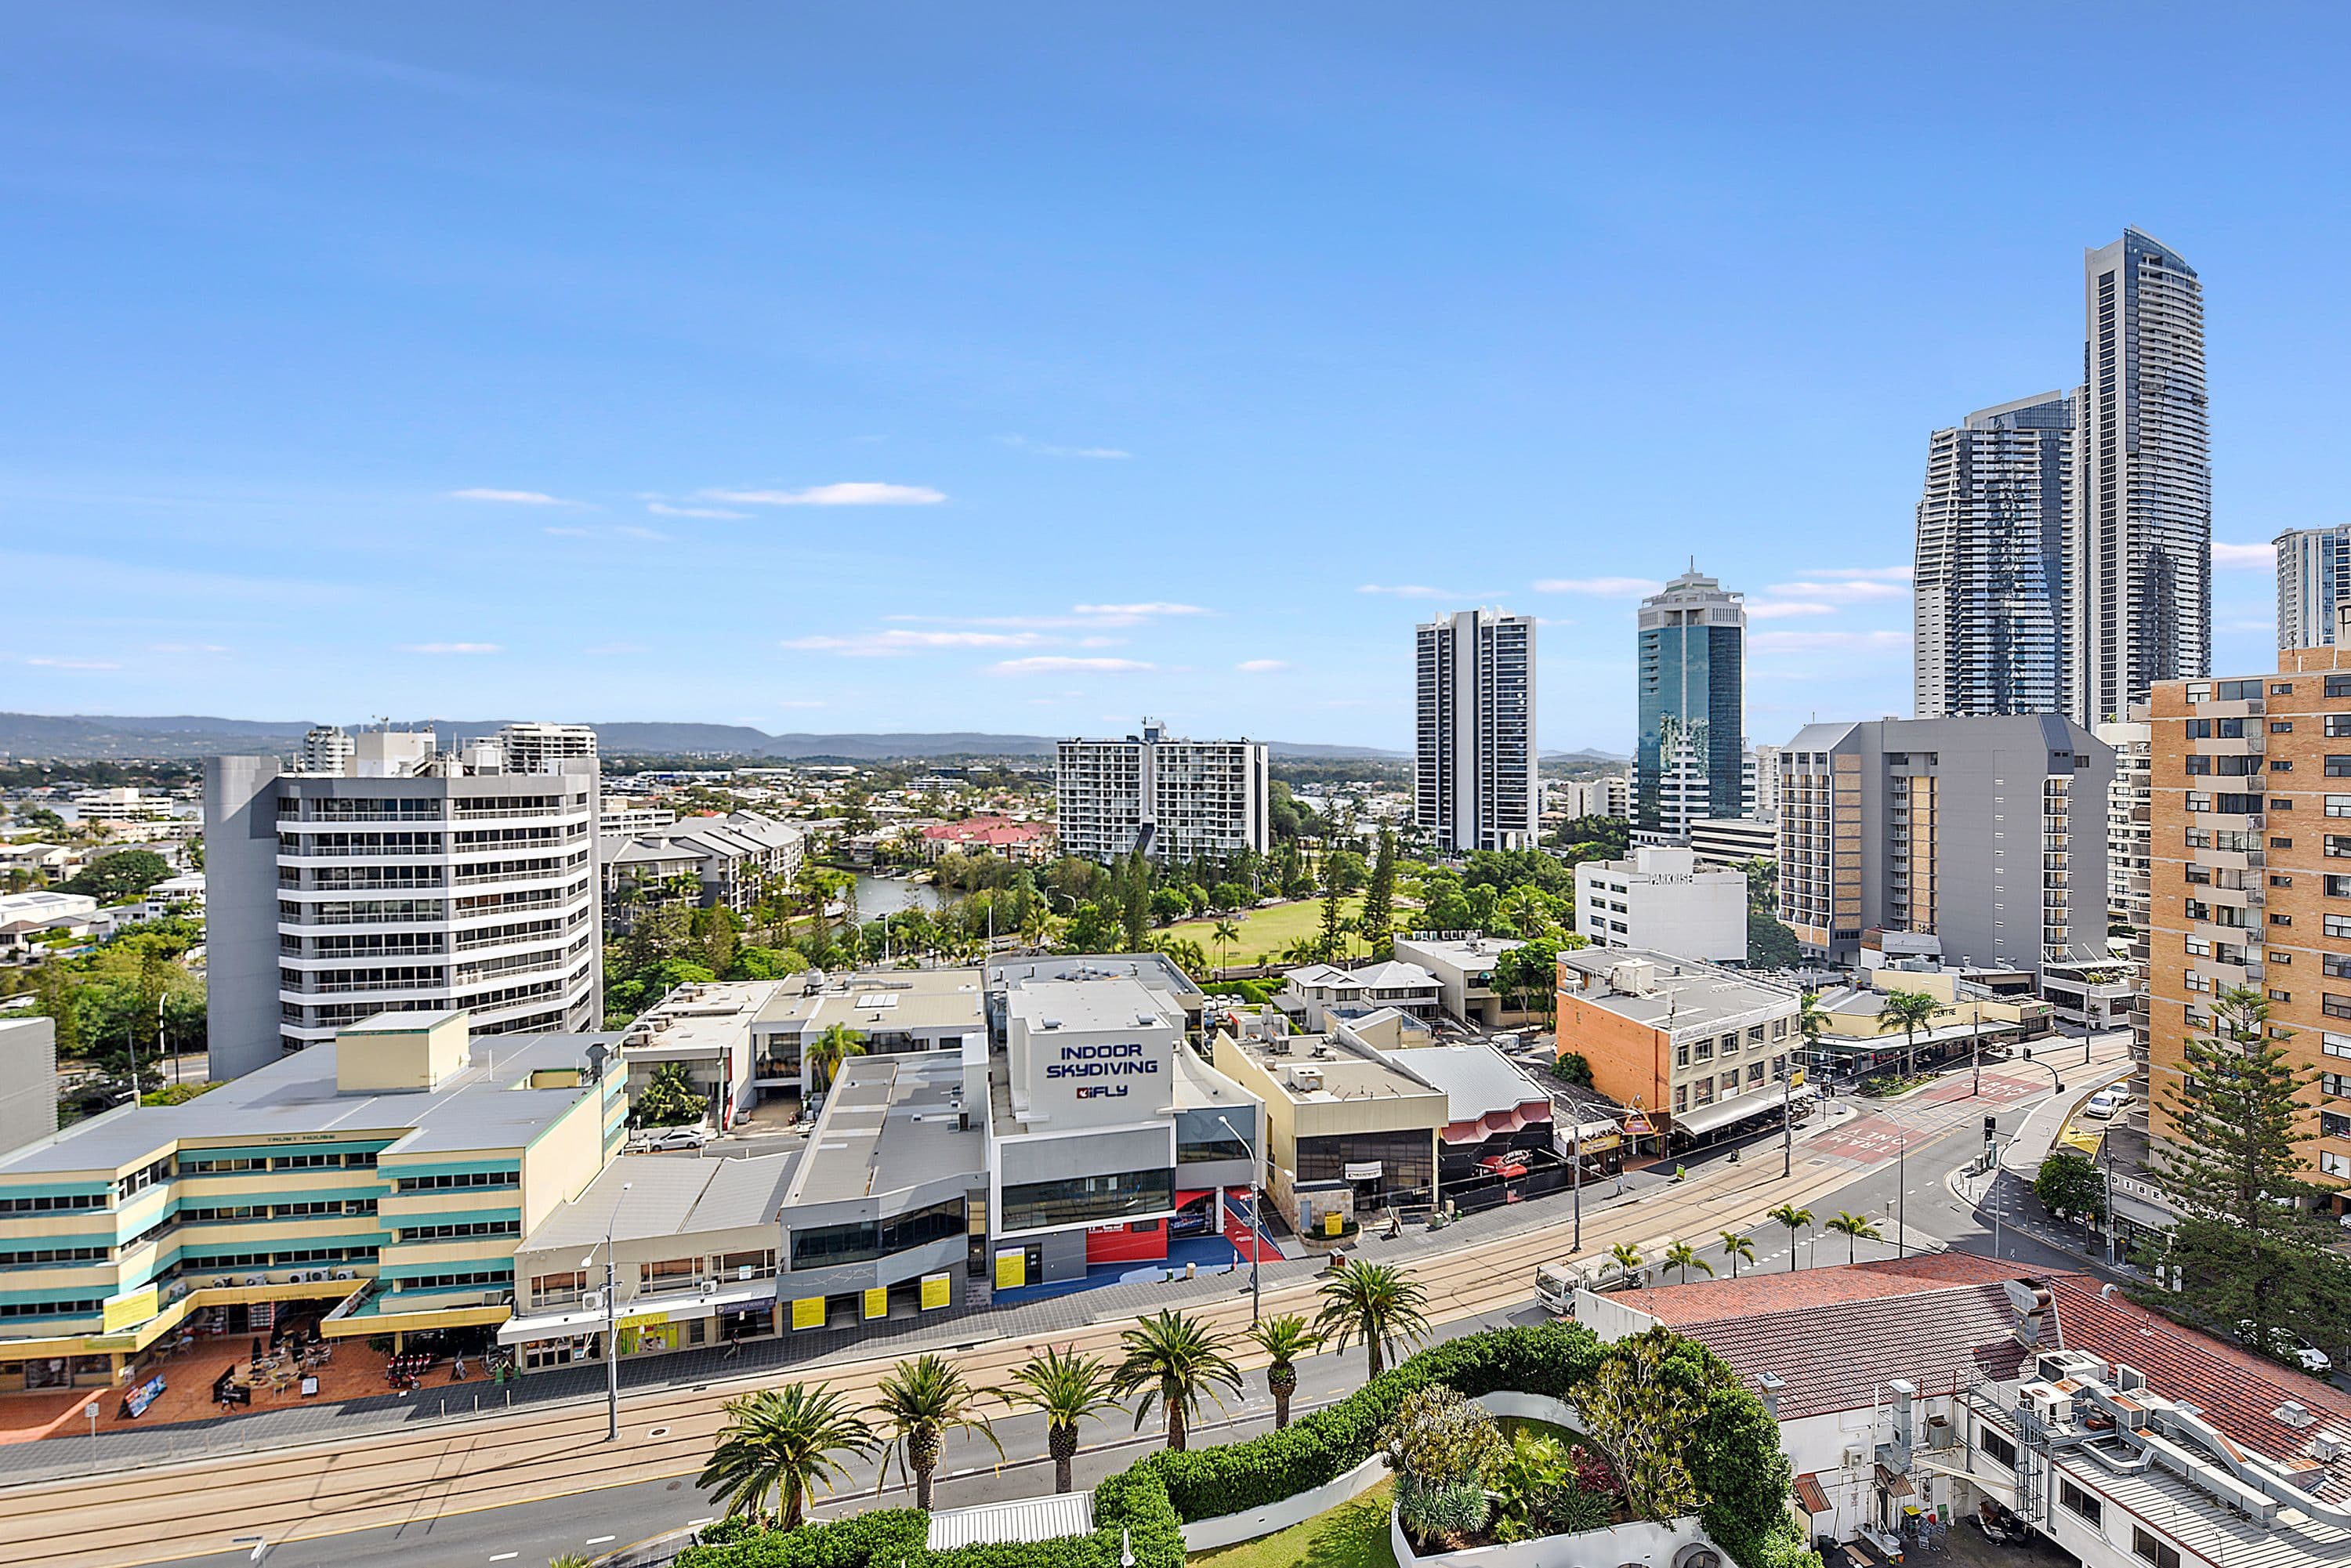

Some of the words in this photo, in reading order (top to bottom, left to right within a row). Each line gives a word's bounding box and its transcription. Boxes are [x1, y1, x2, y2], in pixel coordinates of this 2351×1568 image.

[1649, 872, 1693, 885] PARKRISE
[1933, 1008, 1957, 1019] CENTRE
[1061, 1044, 1143, 1060] INDOOR
[1046, 1060, 1158, 1078] SKYDIVING
[1089, 1085, 1128, 1098] iFLY
[1961, 1083, 2018, 1097] ONLY
[1978, 1078, 2030, 1094] TRAM
[1829, 1134, 1890, 1153] TRAM
[1847, 1128, 1907, 1146] ONLY
